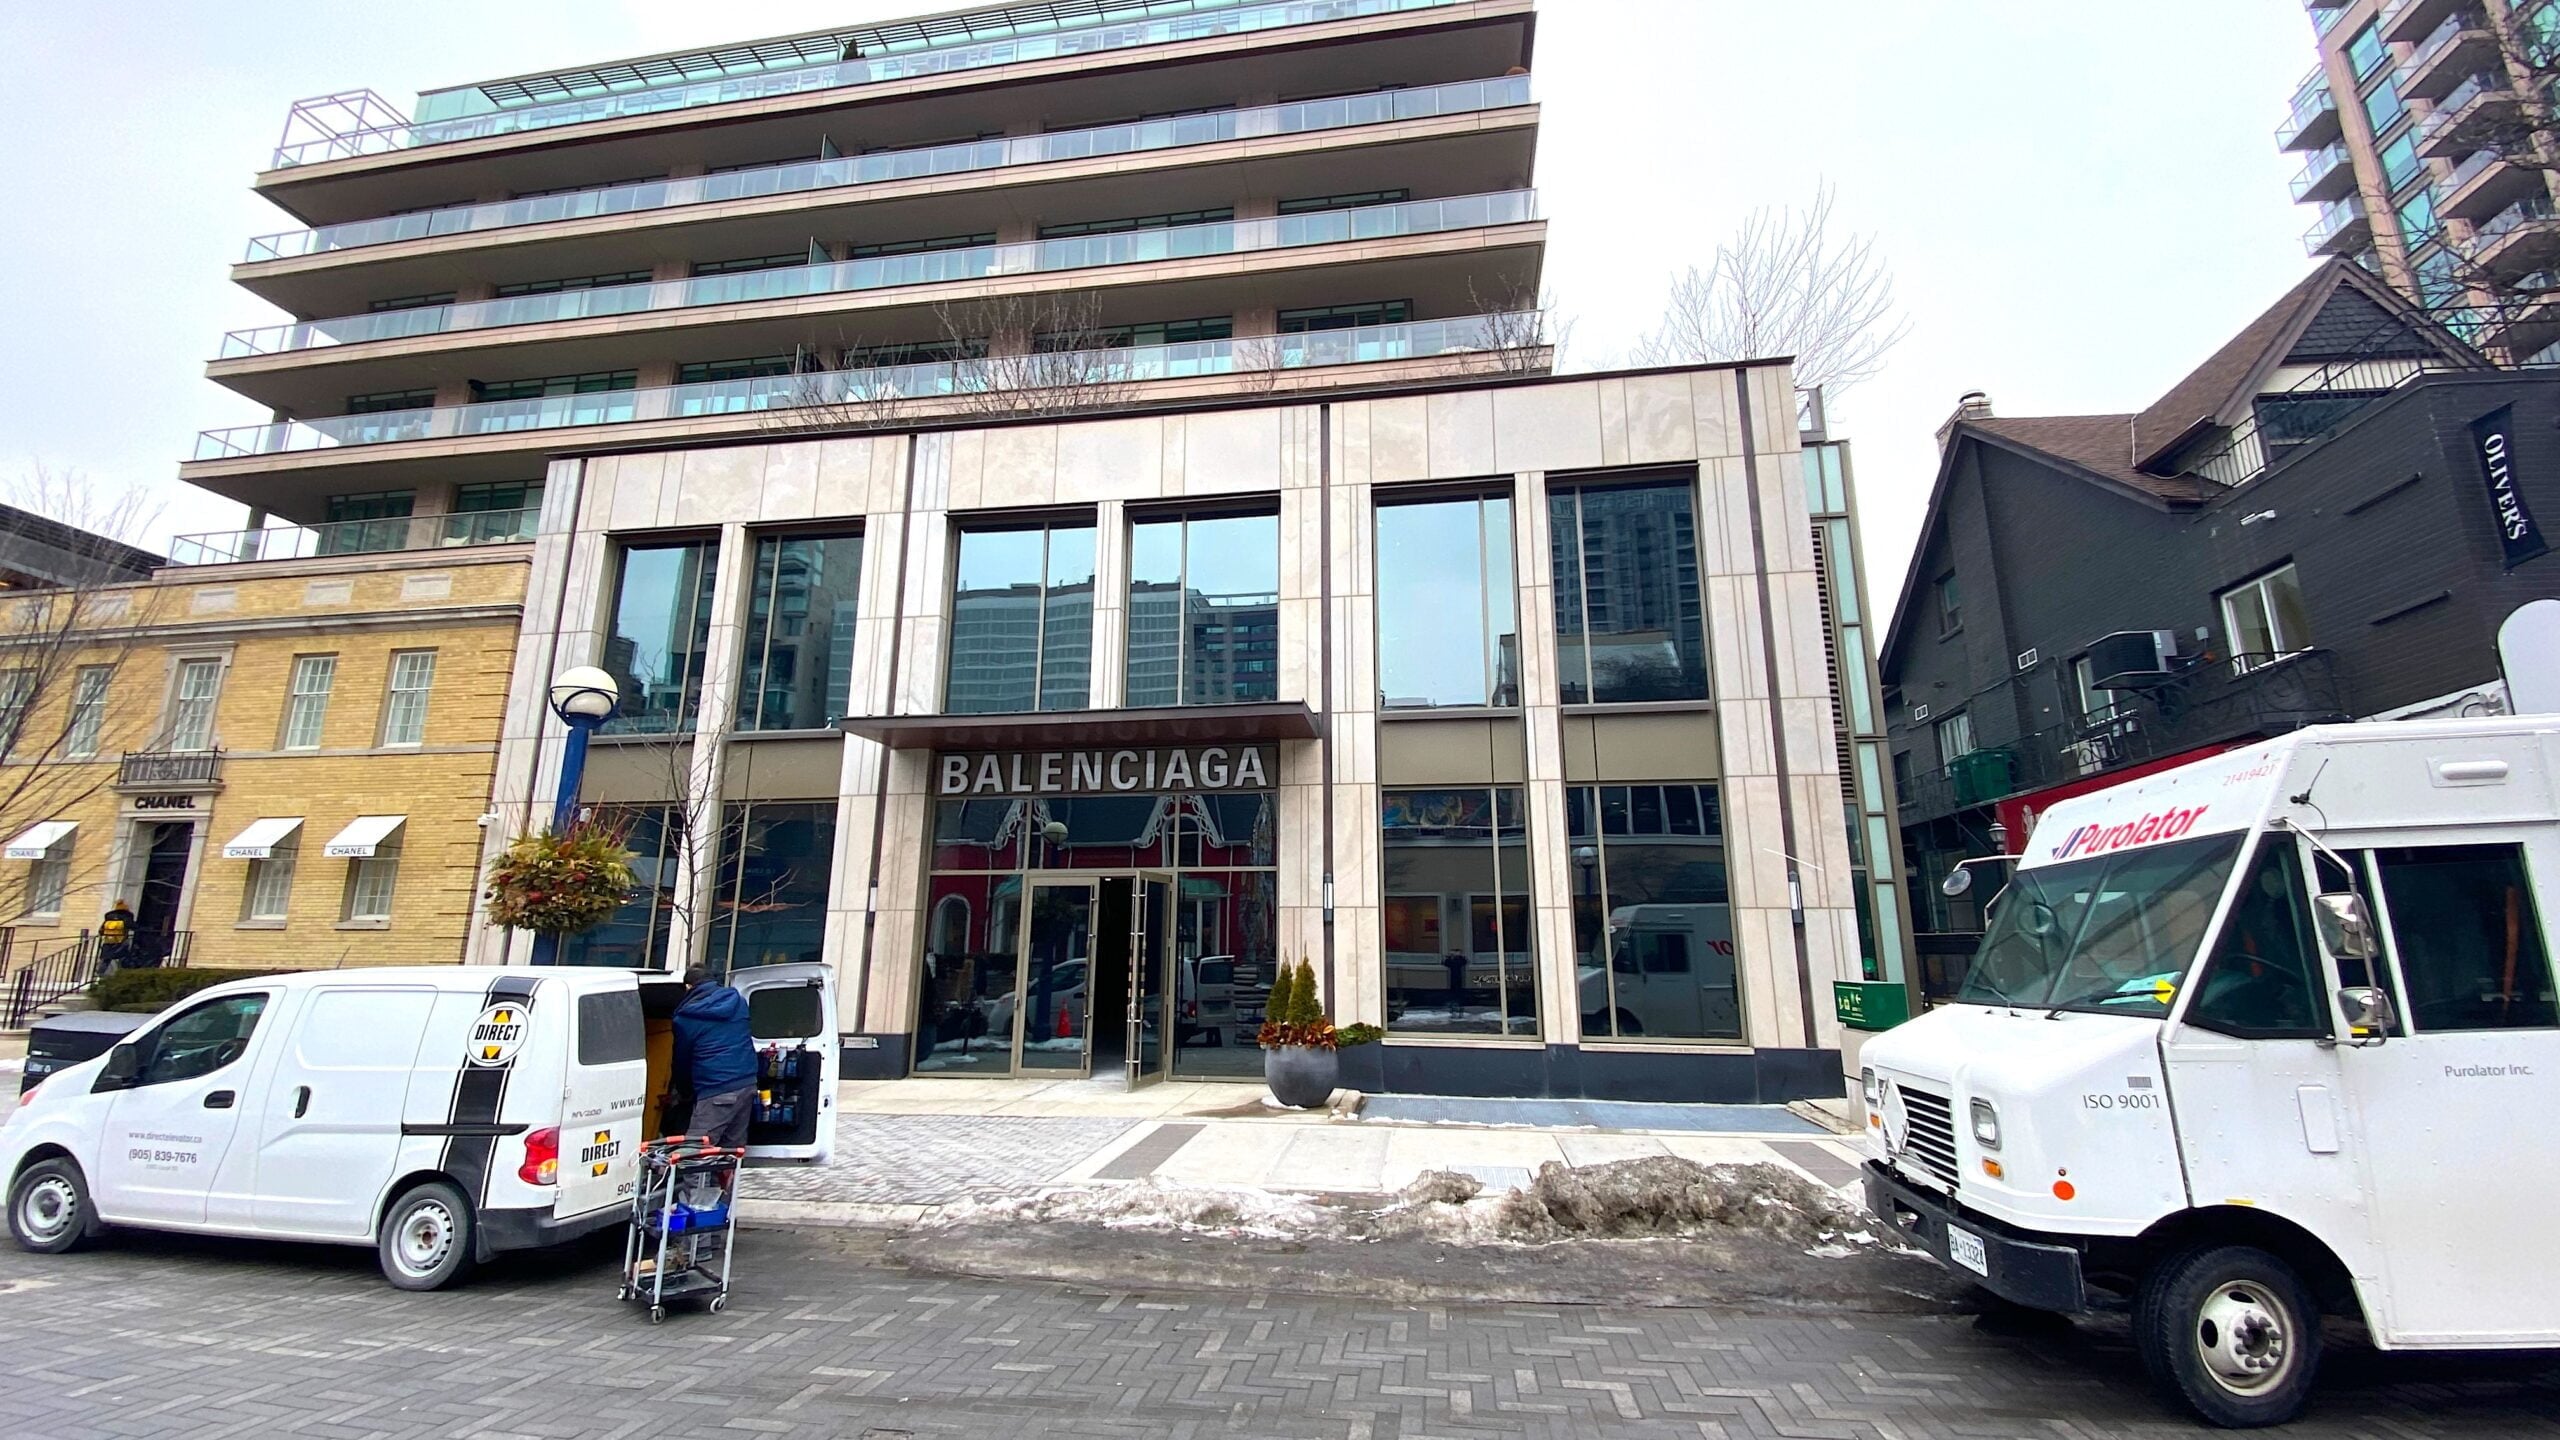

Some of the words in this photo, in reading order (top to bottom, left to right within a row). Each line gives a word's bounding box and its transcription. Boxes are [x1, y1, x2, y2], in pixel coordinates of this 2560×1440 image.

[2484, 433, 2528, 540] OLIVER'S
[941, 746, 1268, 794] BALENCIAGA
[134, 795, 196, 810] CHANEL
[2069, 804, 2209, 857] Purolator
[10, 850, 39, 858] CHANEL
[229, 848, 264, 857] CHANEL
[331, 847, 368, 856] CHANEL
[474, 1024, 522, 1041] DIRECT
[2444, 1064, 2506, 1077] Purolator
[2509, 1064, 2534, 1076] Inc.
[2082, 1094, 2113, 1109] ISO
[2118, 1094, 2160, 1109] 9001
[128, 1148, 152, 1163] (905)
[154, 1150, 197, 1164] 839-7676
[581, 1140, 621, 1163] DIRECT
